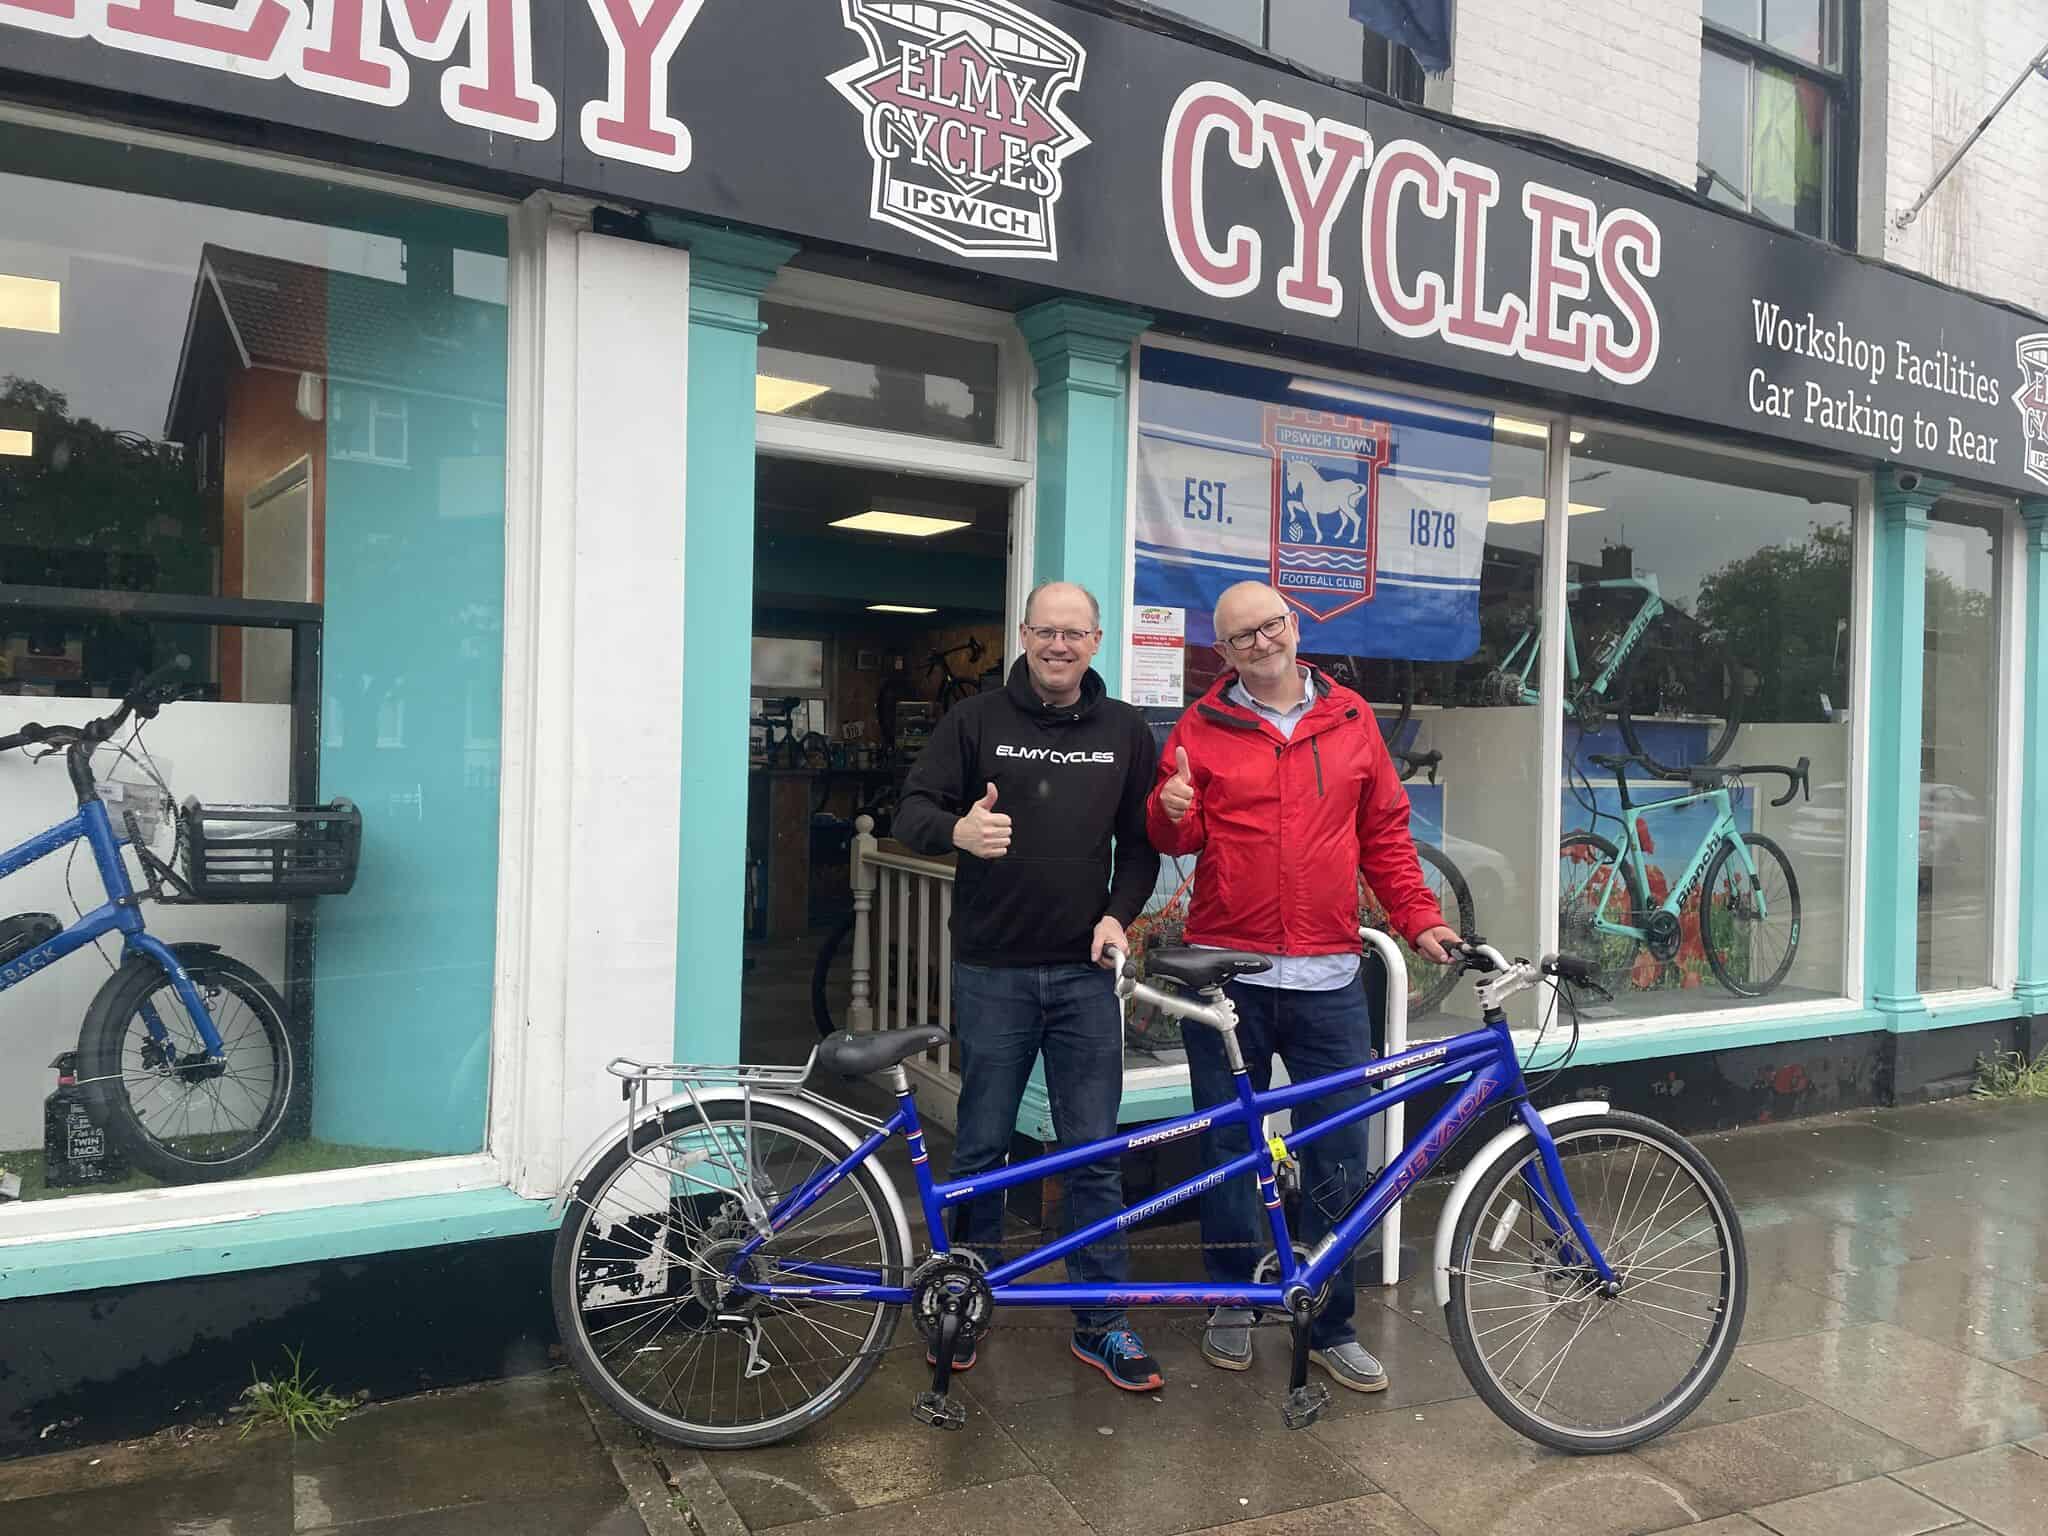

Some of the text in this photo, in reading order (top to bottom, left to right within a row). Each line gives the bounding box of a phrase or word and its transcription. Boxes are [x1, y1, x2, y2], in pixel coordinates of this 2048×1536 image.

[896, 40, 1037, 127] ELMY
[871, 102, 1062, 196] CYCLES
[903, 186, 1030, 233] IPSWICH
[1162, 81, 1661, 385] CYCLES
[1752, 299, 2000, 406] Workshop Facilities
[1280, 429, 1372, 453] IPSWICH TOWN
[1749, 368, 1999, 465] Car Parking to Rear
[1184, 477, 1233, 524] EST.
[1410, 508, 1456, 549] 1878
[1282, 572, 1363, 590] FOOTBALL CLUB
[996, 745, 1114, 764] ELMY CYCLES
[1676, 831, 1722, 908] Bianchi
[74, 1138, 99, 1147] TWIN
[1393, 1078, 1499, 1192] NEVADA
